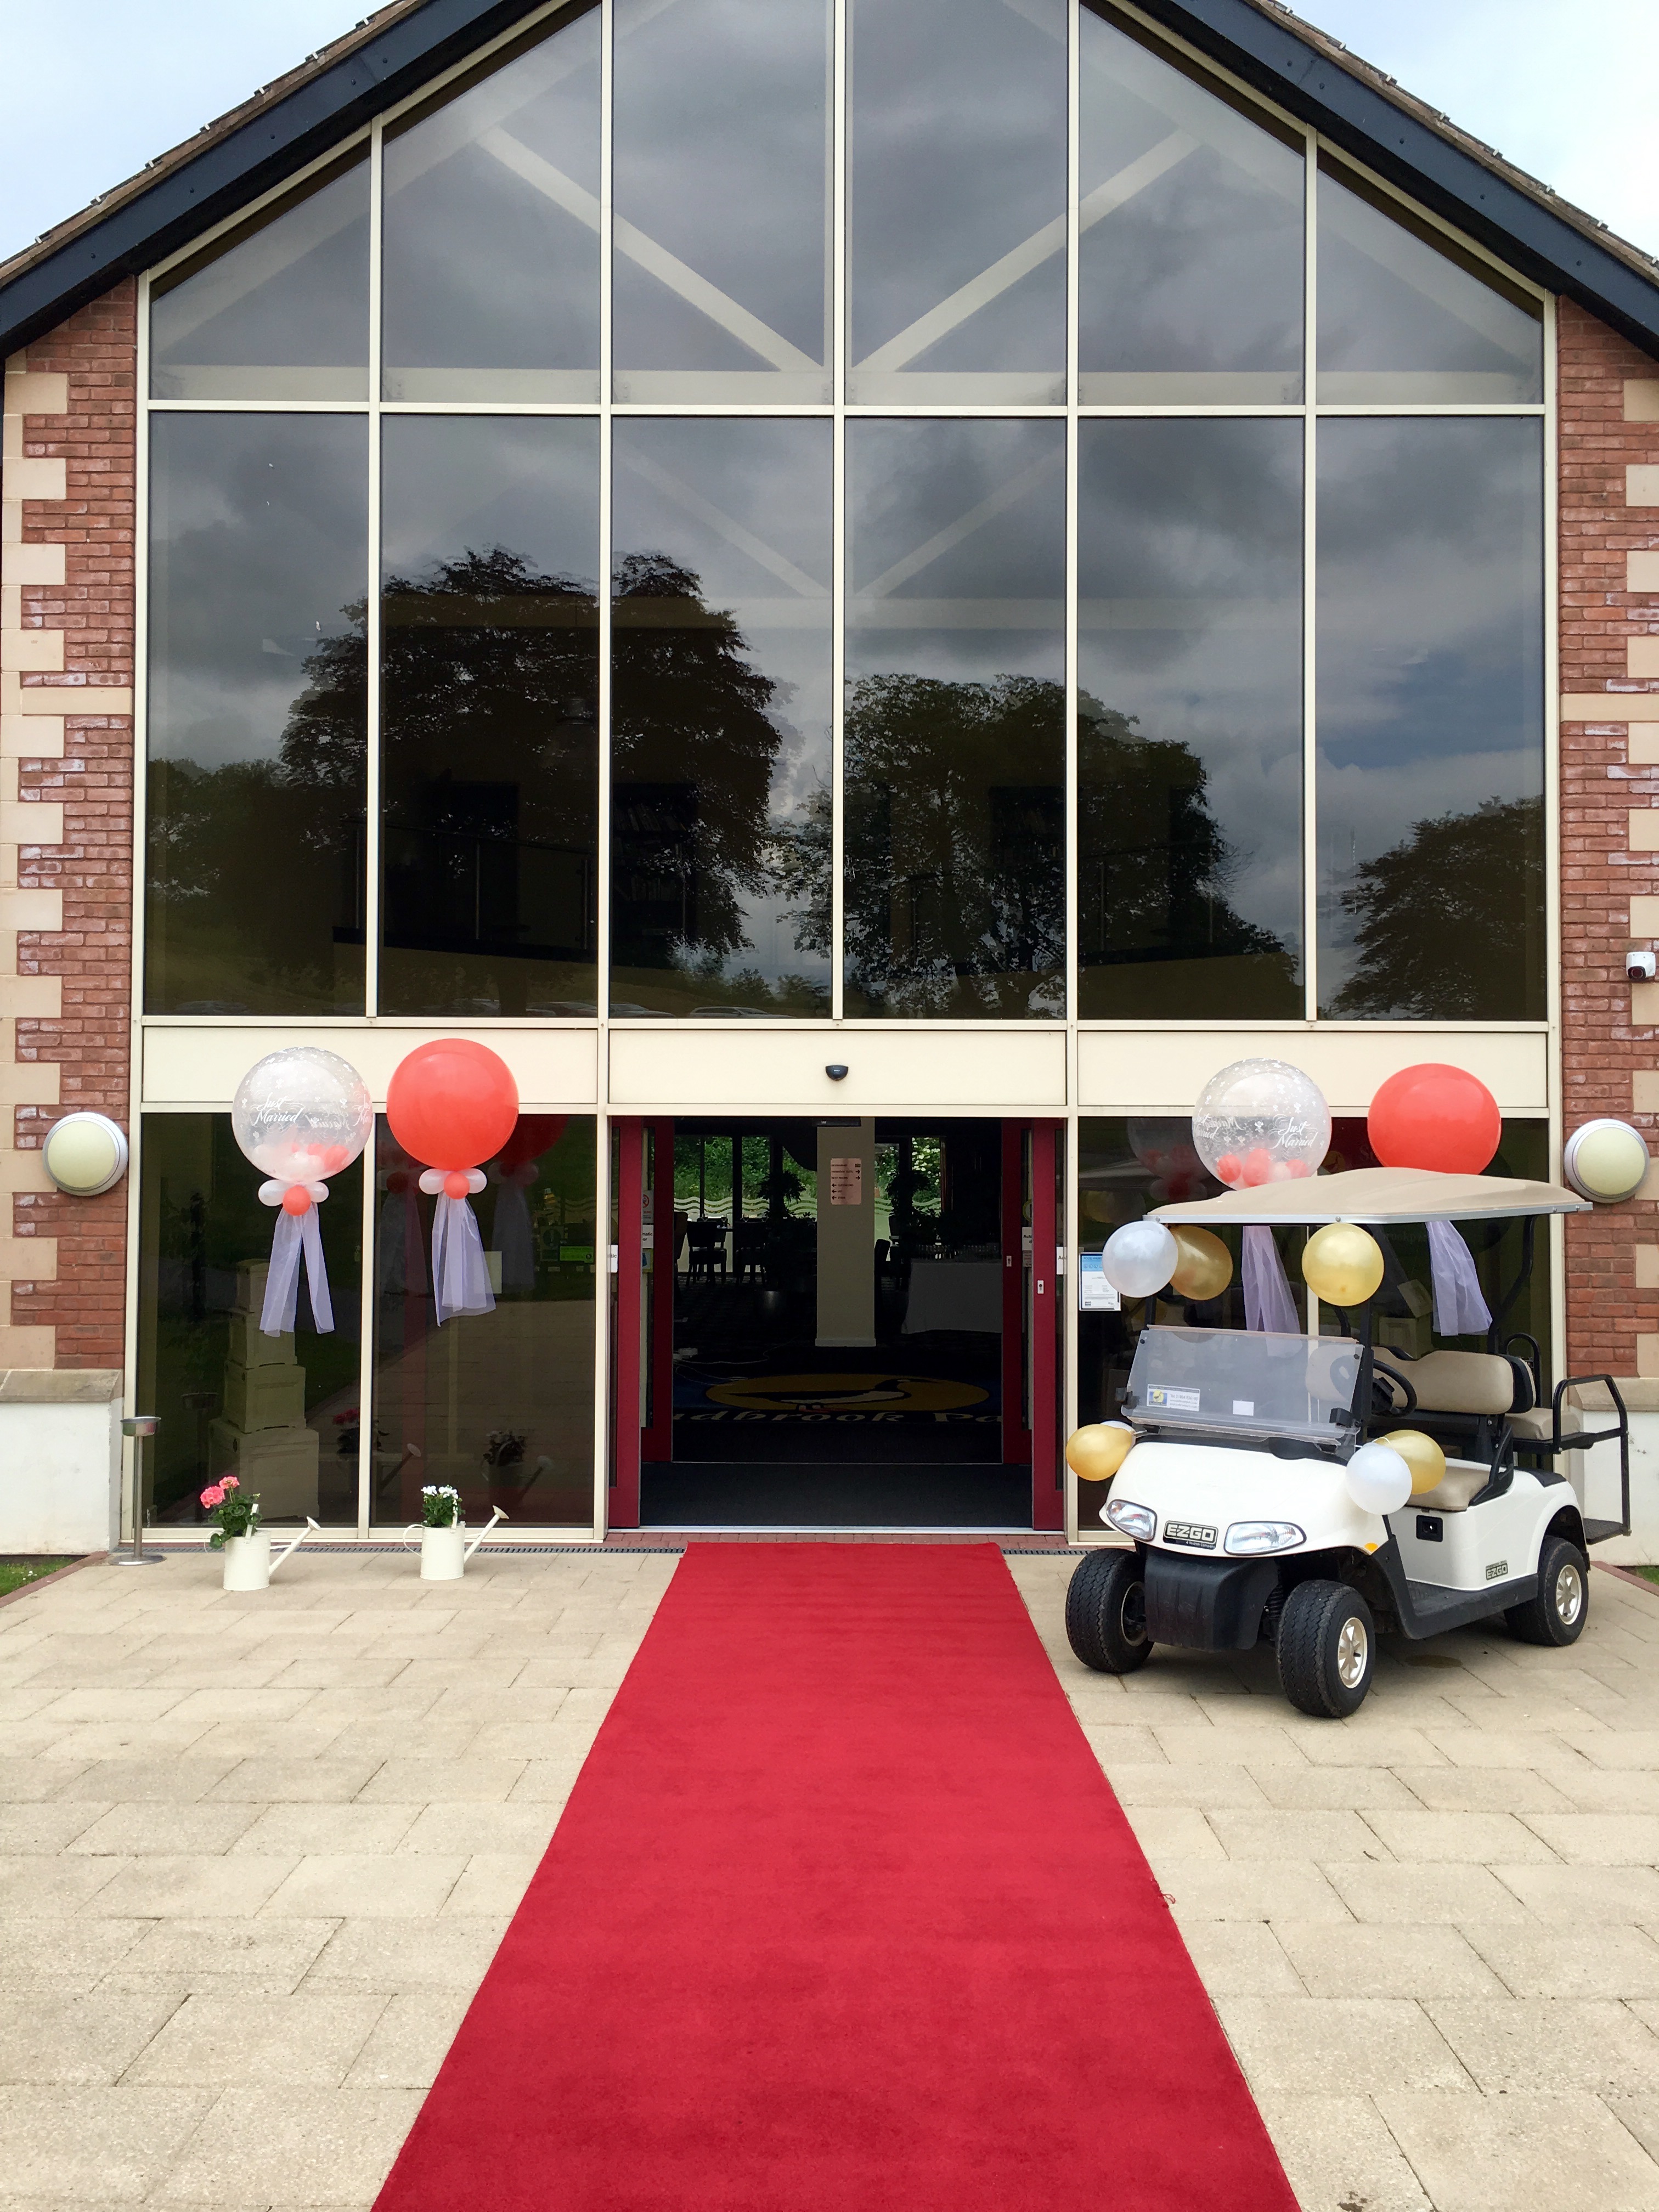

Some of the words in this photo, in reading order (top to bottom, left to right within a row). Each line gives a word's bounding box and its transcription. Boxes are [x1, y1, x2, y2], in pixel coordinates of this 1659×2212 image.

[256, 1092, 295, 1111] Just
[251, 1107, 306, 1126] Married
[1277, 1117, 1312, 1136] Just
[1269, 1132, 1318, 1149] Married
